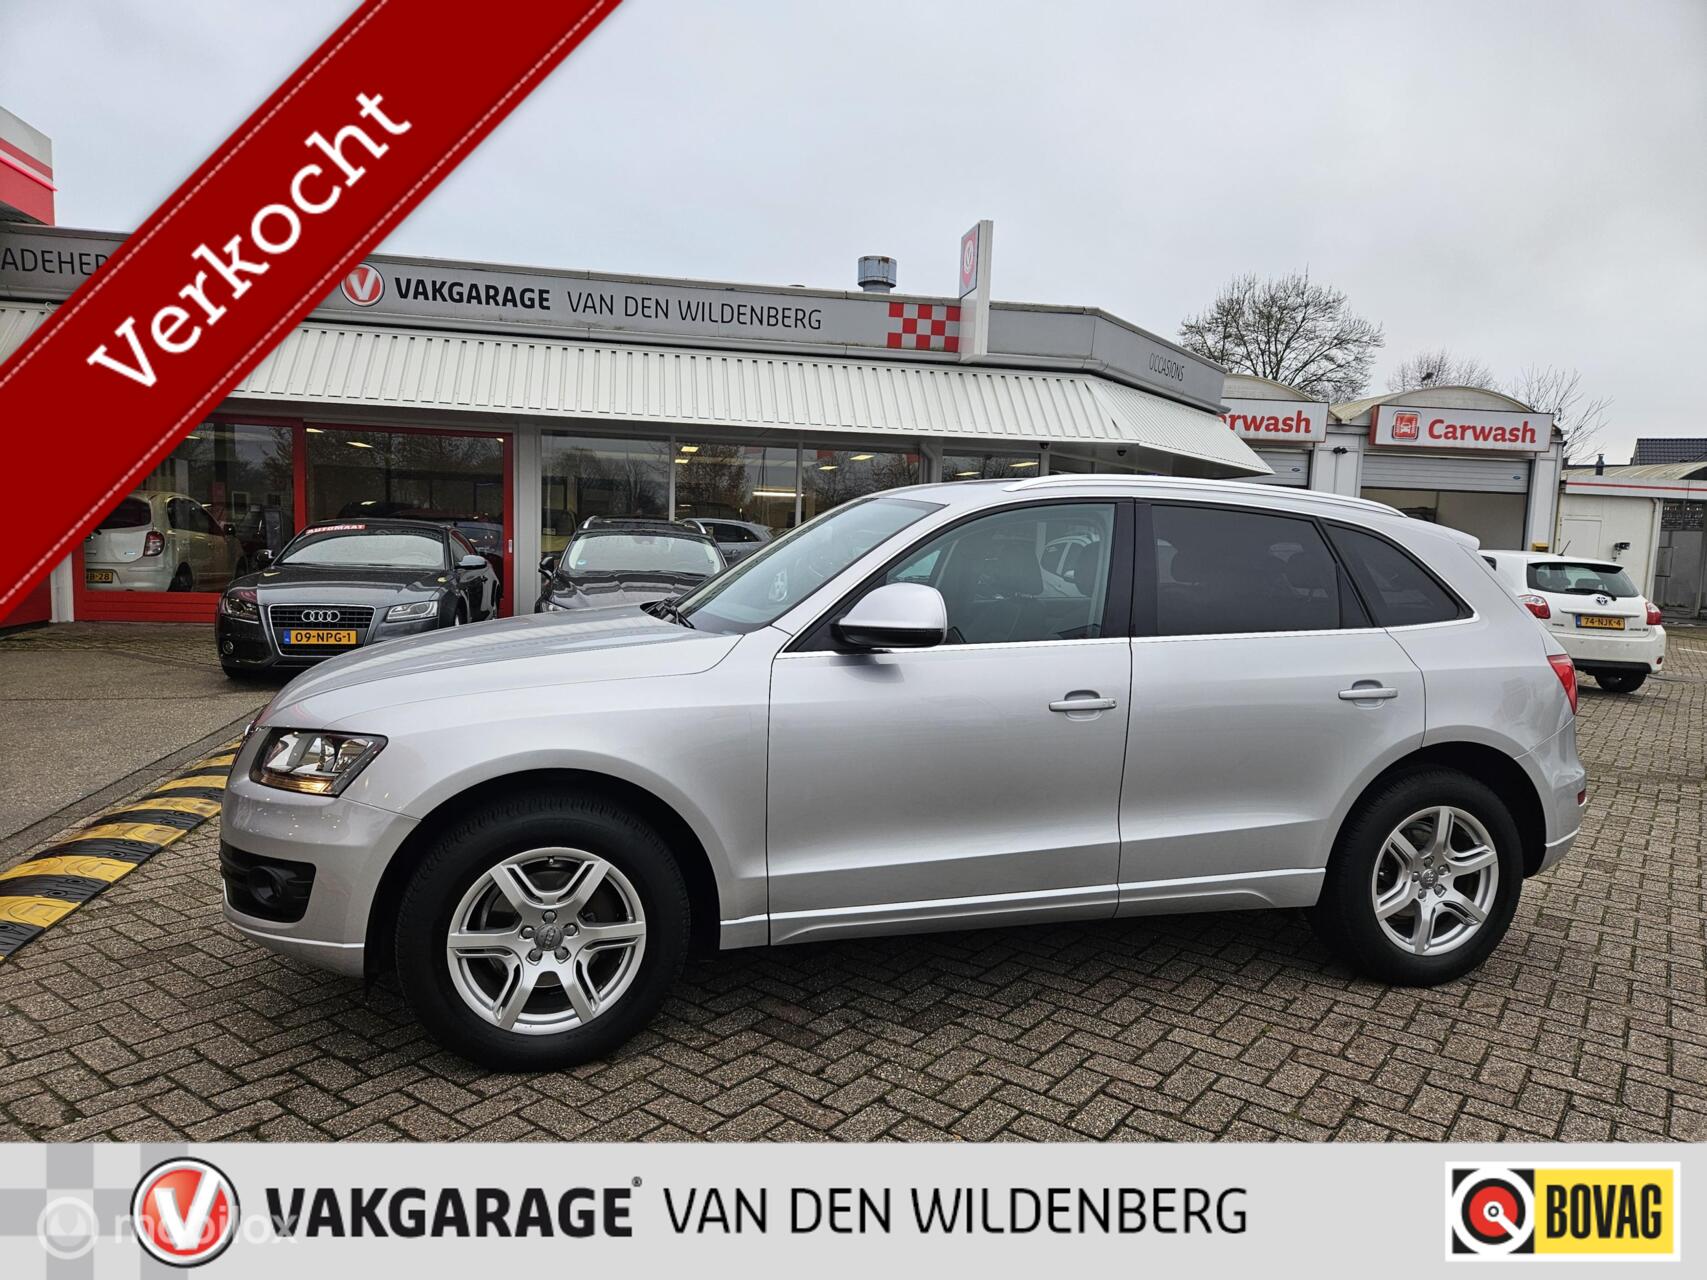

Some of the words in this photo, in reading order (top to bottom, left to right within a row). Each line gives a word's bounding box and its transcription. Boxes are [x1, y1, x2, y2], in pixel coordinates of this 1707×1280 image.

[395, 277, 551, 310] VAKGARAGE
[567, 291, 614, 315] VAN
[624, 296, 669, 319] DEN
[678, 299, 822, 330] WILDENBERG
[1149, 352, 1185, 382] OCCASIONS
[1428, 418, 1537, 444] Carwash
[295, 631, 351, 643] 09-NPG-1
